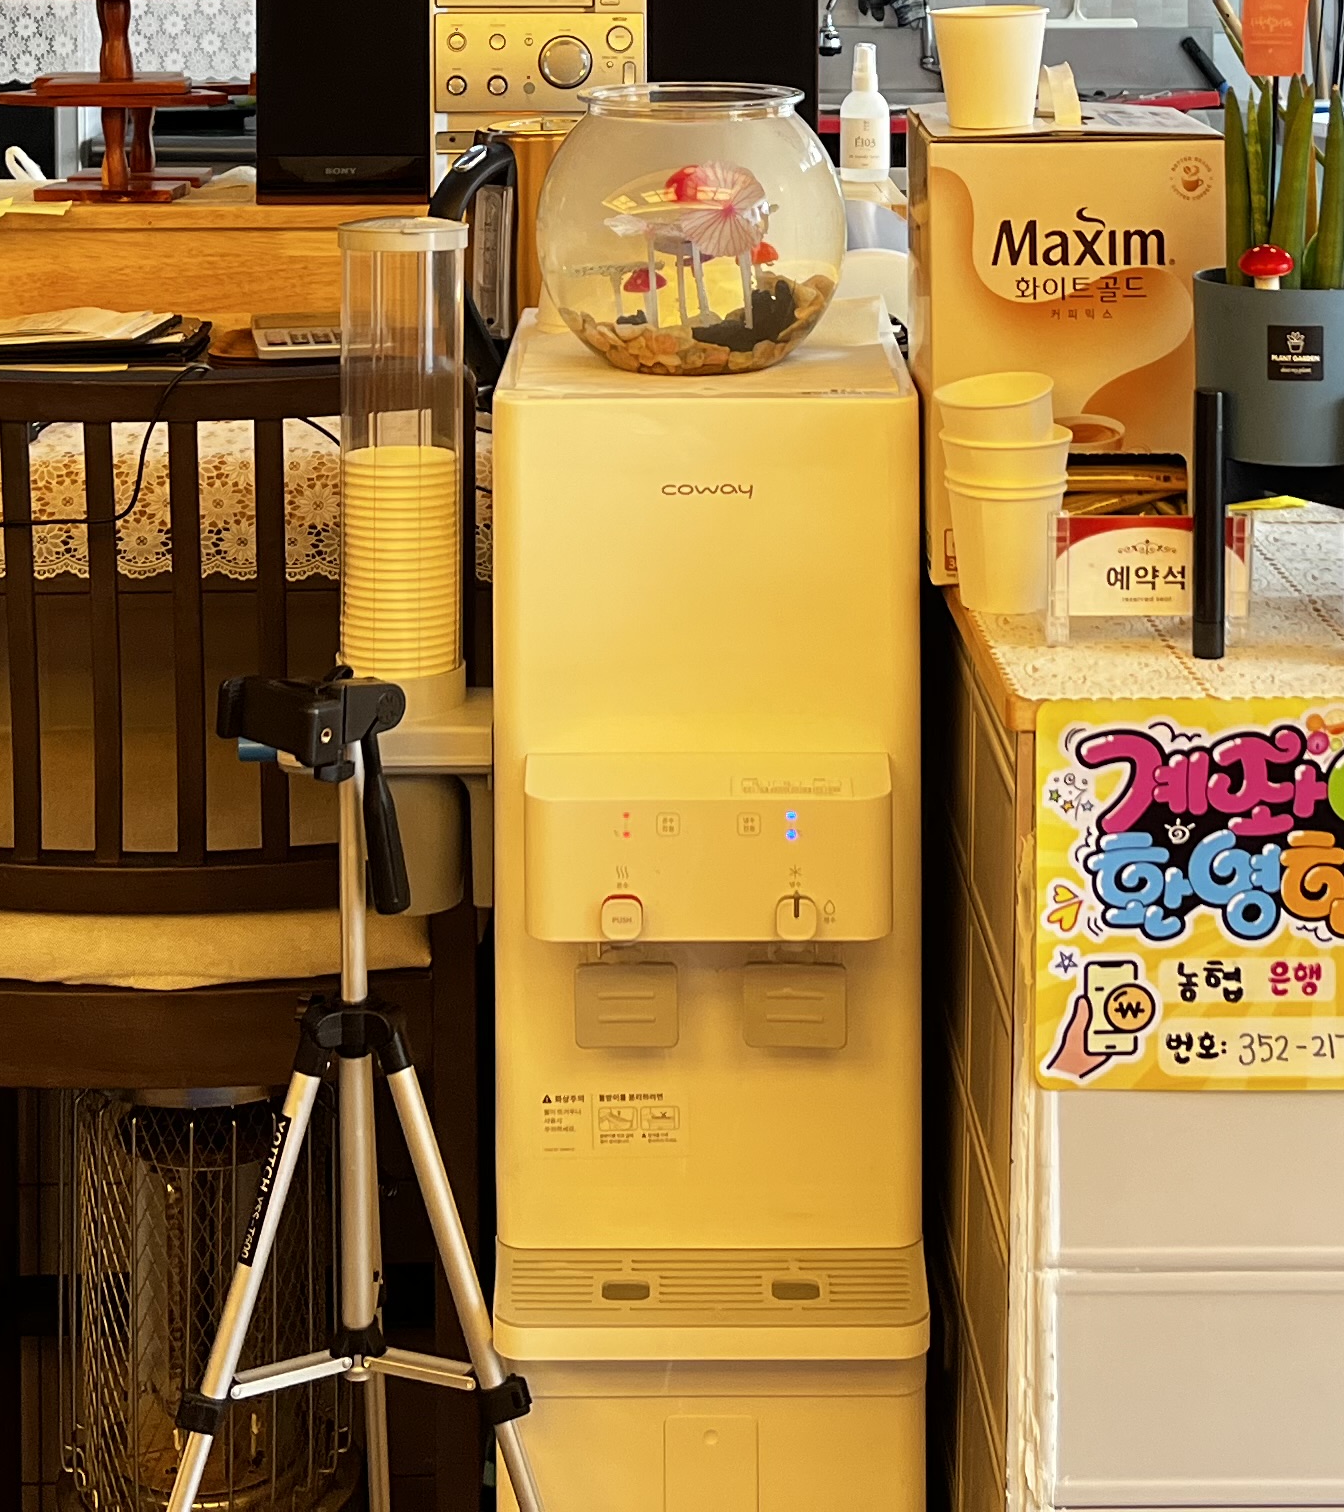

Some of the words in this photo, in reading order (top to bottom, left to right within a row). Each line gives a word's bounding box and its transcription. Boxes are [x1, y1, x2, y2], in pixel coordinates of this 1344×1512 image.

[324, 167, 357, 176] SONY
[991, 207, 1166, 266] Maxim
[1015, 276, 1148, 303] 화이트골드
[1050, 307, 1114, 320] 커피믹스
[660, 483, 754, 499] coway
[1106, 565, 1186, 591] 예약석
[1176, 959, 1243, 1003] 농협
[1267, 960, 1323, 997] 은행
[1165, 1032, 1228, 1066] 번호:
